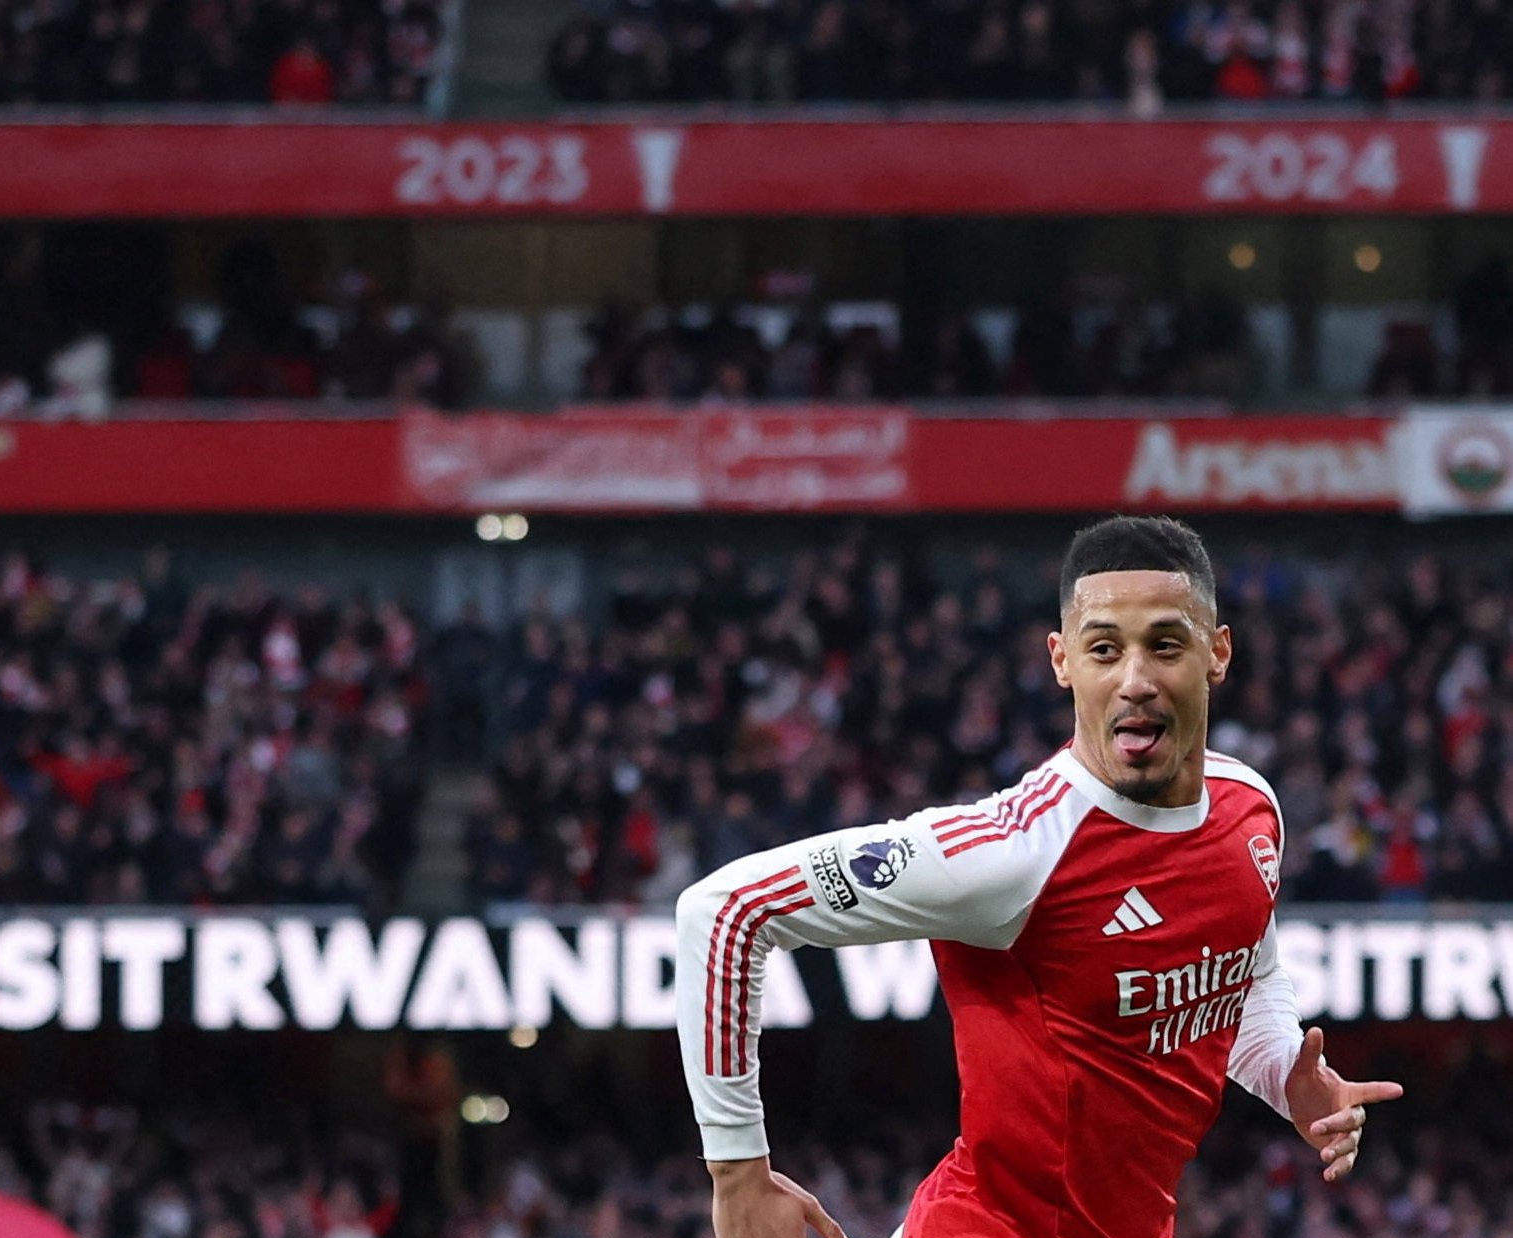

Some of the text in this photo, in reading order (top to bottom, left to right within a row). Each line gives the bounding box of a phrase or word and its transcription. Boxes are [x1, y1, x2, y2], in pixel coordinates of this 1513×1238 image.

[396, 136, 590, 206] 2023
[1202, 132, 1399, 202] 2024
[826, 862, 853, 905] room
[1147, 1007, 1192, 1055] FLY
